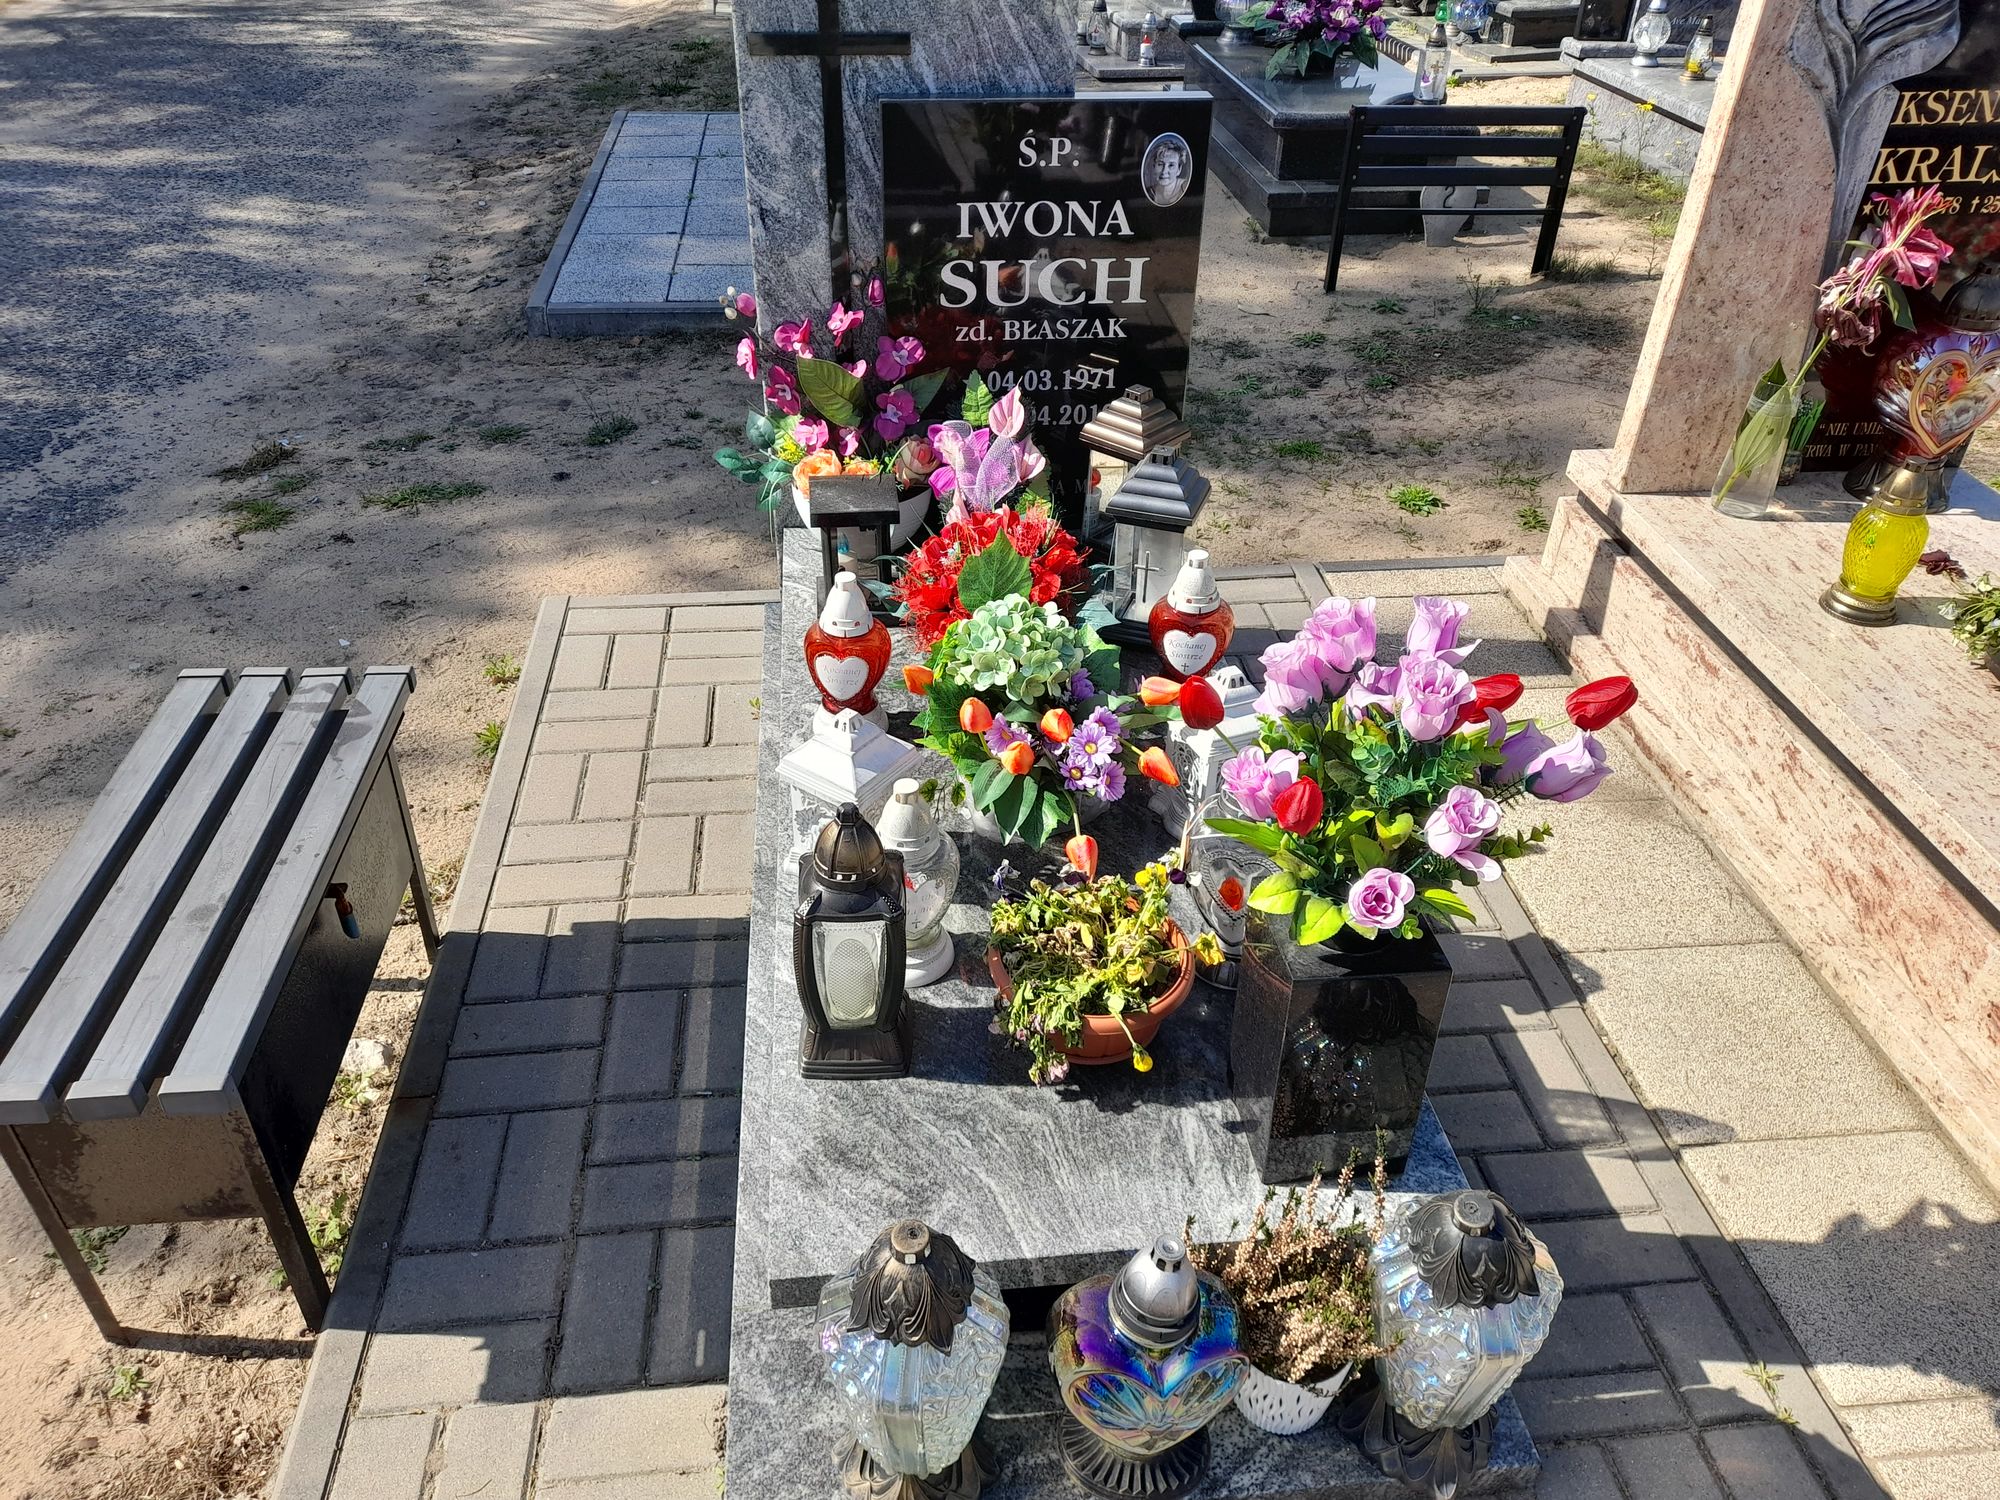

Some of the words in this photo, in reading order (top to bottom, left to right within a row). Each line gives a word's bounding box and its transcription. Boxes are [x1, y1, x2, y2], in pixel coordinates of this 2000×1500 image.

[1018, 129, 1080, 168] Ś.P.
[1866, 145, 2000, 184] KRAL
[956, 199, 1135, 239] IWONA
[939, 256, 1151, 308] SUCH
[955, 320, 994, 343] zd.
[1003, 317, 1128, 341] BŁASZAK
[1170, 650, 1204, 661] Siostrze
